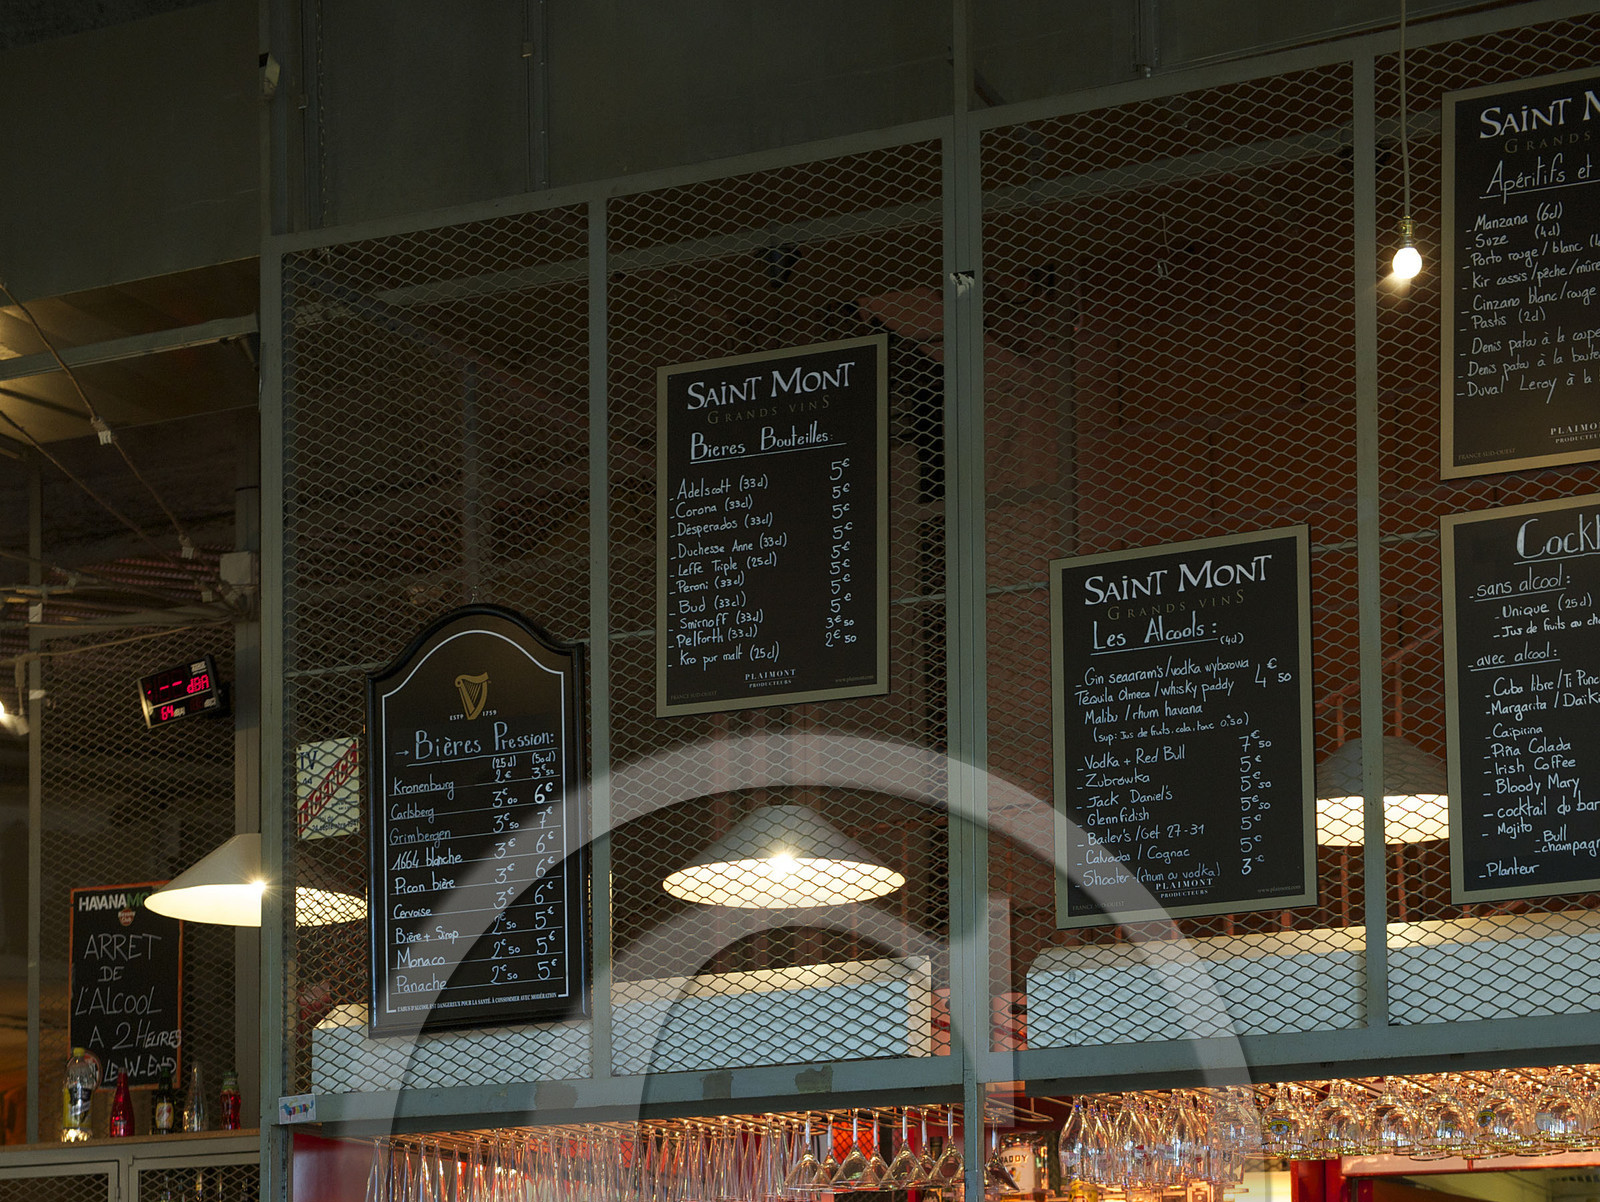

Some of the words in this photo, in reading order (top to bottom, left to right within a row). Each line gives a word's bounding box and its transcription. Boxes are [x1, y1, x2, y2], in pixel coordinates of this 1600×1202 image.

[1486, 152, 1566, 205] Apéritifs
[1577, 153, 1593, 179] et
[1474, 214, 1529, 232] Manzana
[1475, 233, 1509, 248] Suze
[1470, 249, 1502, 267] Porto
[1508, 247, 1539, 268] rouge
[1552, 240, 1583, 254] blanc
[1472, 271, 1491, 289] Kir
[1496, 272, 1528, 286] cassis
[1472, 294, 1520, 311] Cinzano
[1470, 311, 1507, 330] Pastis
[1471, 336, 1502, 355] Denis
[1541, 331, 1551, 345] à
[1467, 361, 1497, 377] Denis
[1537, 353, 1546, 367] à
[1553, 348, 1564, 365] la
[770, 361, 855, 398] MONT
[1467, 375, 1505, 397] Duval
[1519, 374, 1557, 404] Leroy
[690, 431, 746, 460] Bieres
[676, 477, 731, 500] Adelscott
[675, 501, 717, 519] Corona
[677, 541, 726, 559] Duchesse
[731, 539, 754, 553] Anne
[677, 561, 704, 577] Leffe
[711, 556, 738, 576] Triple
[1178, 554, 1273, 592] MONT
[675, 579, 709, 593] Peroni
[1477, 581, 1513, 597] sans
[678, 596, 706, 614] Bud
[1502, 603, 1550, 618] Unique
[680, 611, 730, 631] Smirnoff
[1501, 625, 1523, 638] Jus
[1526, 620, 1538, 634] de
[1543, 615, 1566, 631] fruits
[676, 628, 724, 648] Pelforth
[1093, 620, 1127, 651] Les
[680, 649, 697, 666] Kro
[722, 643, 743, 661] malt
[1476, 654, 1506, 667] avec
[744, 668, 797, 681] PLAIMONT
[1084, 666, 1105, 687] Gin
[1493, 676, 1524, 697] Cuba
[1530, 673, 1554, 692] libre
[1118, 687, 1150, 702] Olmeca
[1201, 676, 1235, 703] paddy
[482, 709, 497, 717] 1759
[1164, 700, 1203, 717] havana
[1491, 694, 1548, 721] Margarita
[415, 728, 482, 760] Bières
[1490, 742, 1522, 758] Piña
[1528, 736, 1572, 753] Colada
[1084, 751, 1121, 770] Vodka
[1135, 747, 1159, 765] Red
[1163, 743, 1186, 761] Bull
[1495, 757, 1525, 775] Irish
[1533, 754, 1577, 771] Coffee
[1086, 790, 1120, 809] Jack
[1129, 784, 1174, 804] Daniel's
[1495, 774, 1541, 796] Bloody
[1547, 772, 1580, 799] Mary
[390, 802, 435, 824] Carlsberg
[1497, 795, 1547, 819] cocktail
[1557, 795, 1571, 816] du
[389, 826, 452, 848] Grimbergen
[1497, 816, 1533, 840] Mojito
[1543, 823, 1567, 842] Bull
[391, 848, 420, 871] 1664
[1085, 848, 1131, 866] Calvados
[1147, 846, 1191, 865] Cognac
[1485, 856, 1540, 878] Planteur
[394, 876, 426, 895] Picon
[431, 870, 456, 890] bière
[1082, 869, 1130, 887] Shooter
[1154, 878, 1214, 891] PLAIMONT
[393, 903, 433, 920] Cervoise
[435, 925, 460, 944] Sirop
[83, 932, 162, 962] ARRET
[397, 946, 446, 970] Monaco
[97, 965, 125, 982] DE
[396, 972, 447, 993] Panache
[75, 984, 162, 1016] L'ALCOOL
[88, 1024, 105, 1048] A
[111, 1020, 134, 1050] 2
